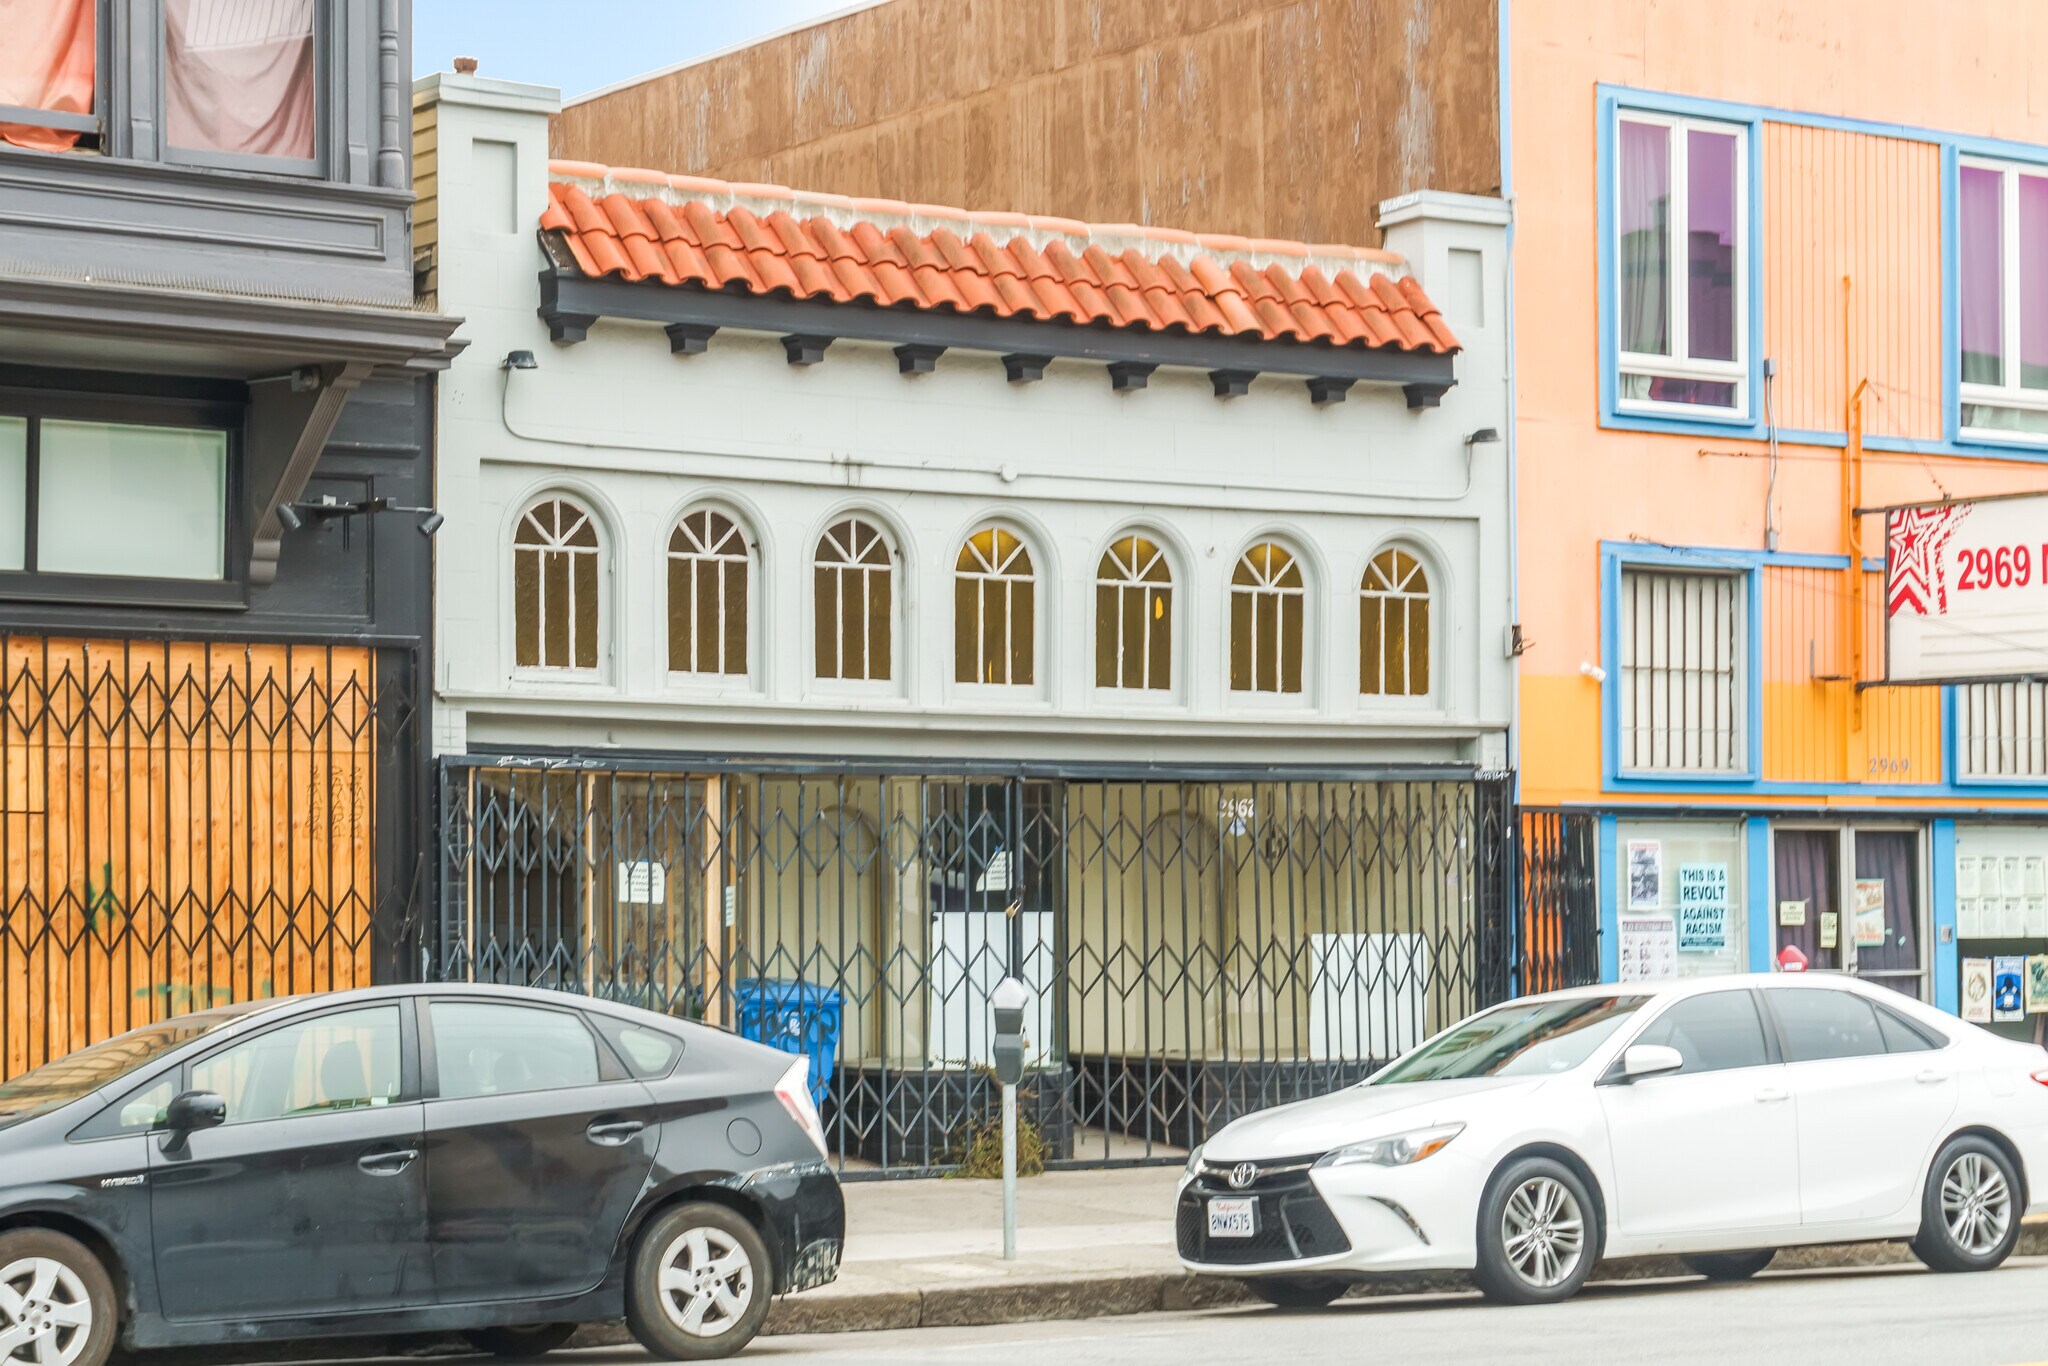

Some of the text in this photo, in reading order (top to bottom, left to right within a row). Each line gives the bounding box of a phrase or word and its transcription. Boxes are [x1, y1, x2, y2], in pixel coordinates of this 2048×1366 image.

[1957, 544, 2032, 590] 2969
[1869, 757, 1910, 773] 2969
[1682, 869, 1726, 882] THIS IS A
[1683, 885, 1726, 901] REVOLT
[1683, 907, 1726, 920] AGAINST
[1685, 922, 1722, 935] RACISM
